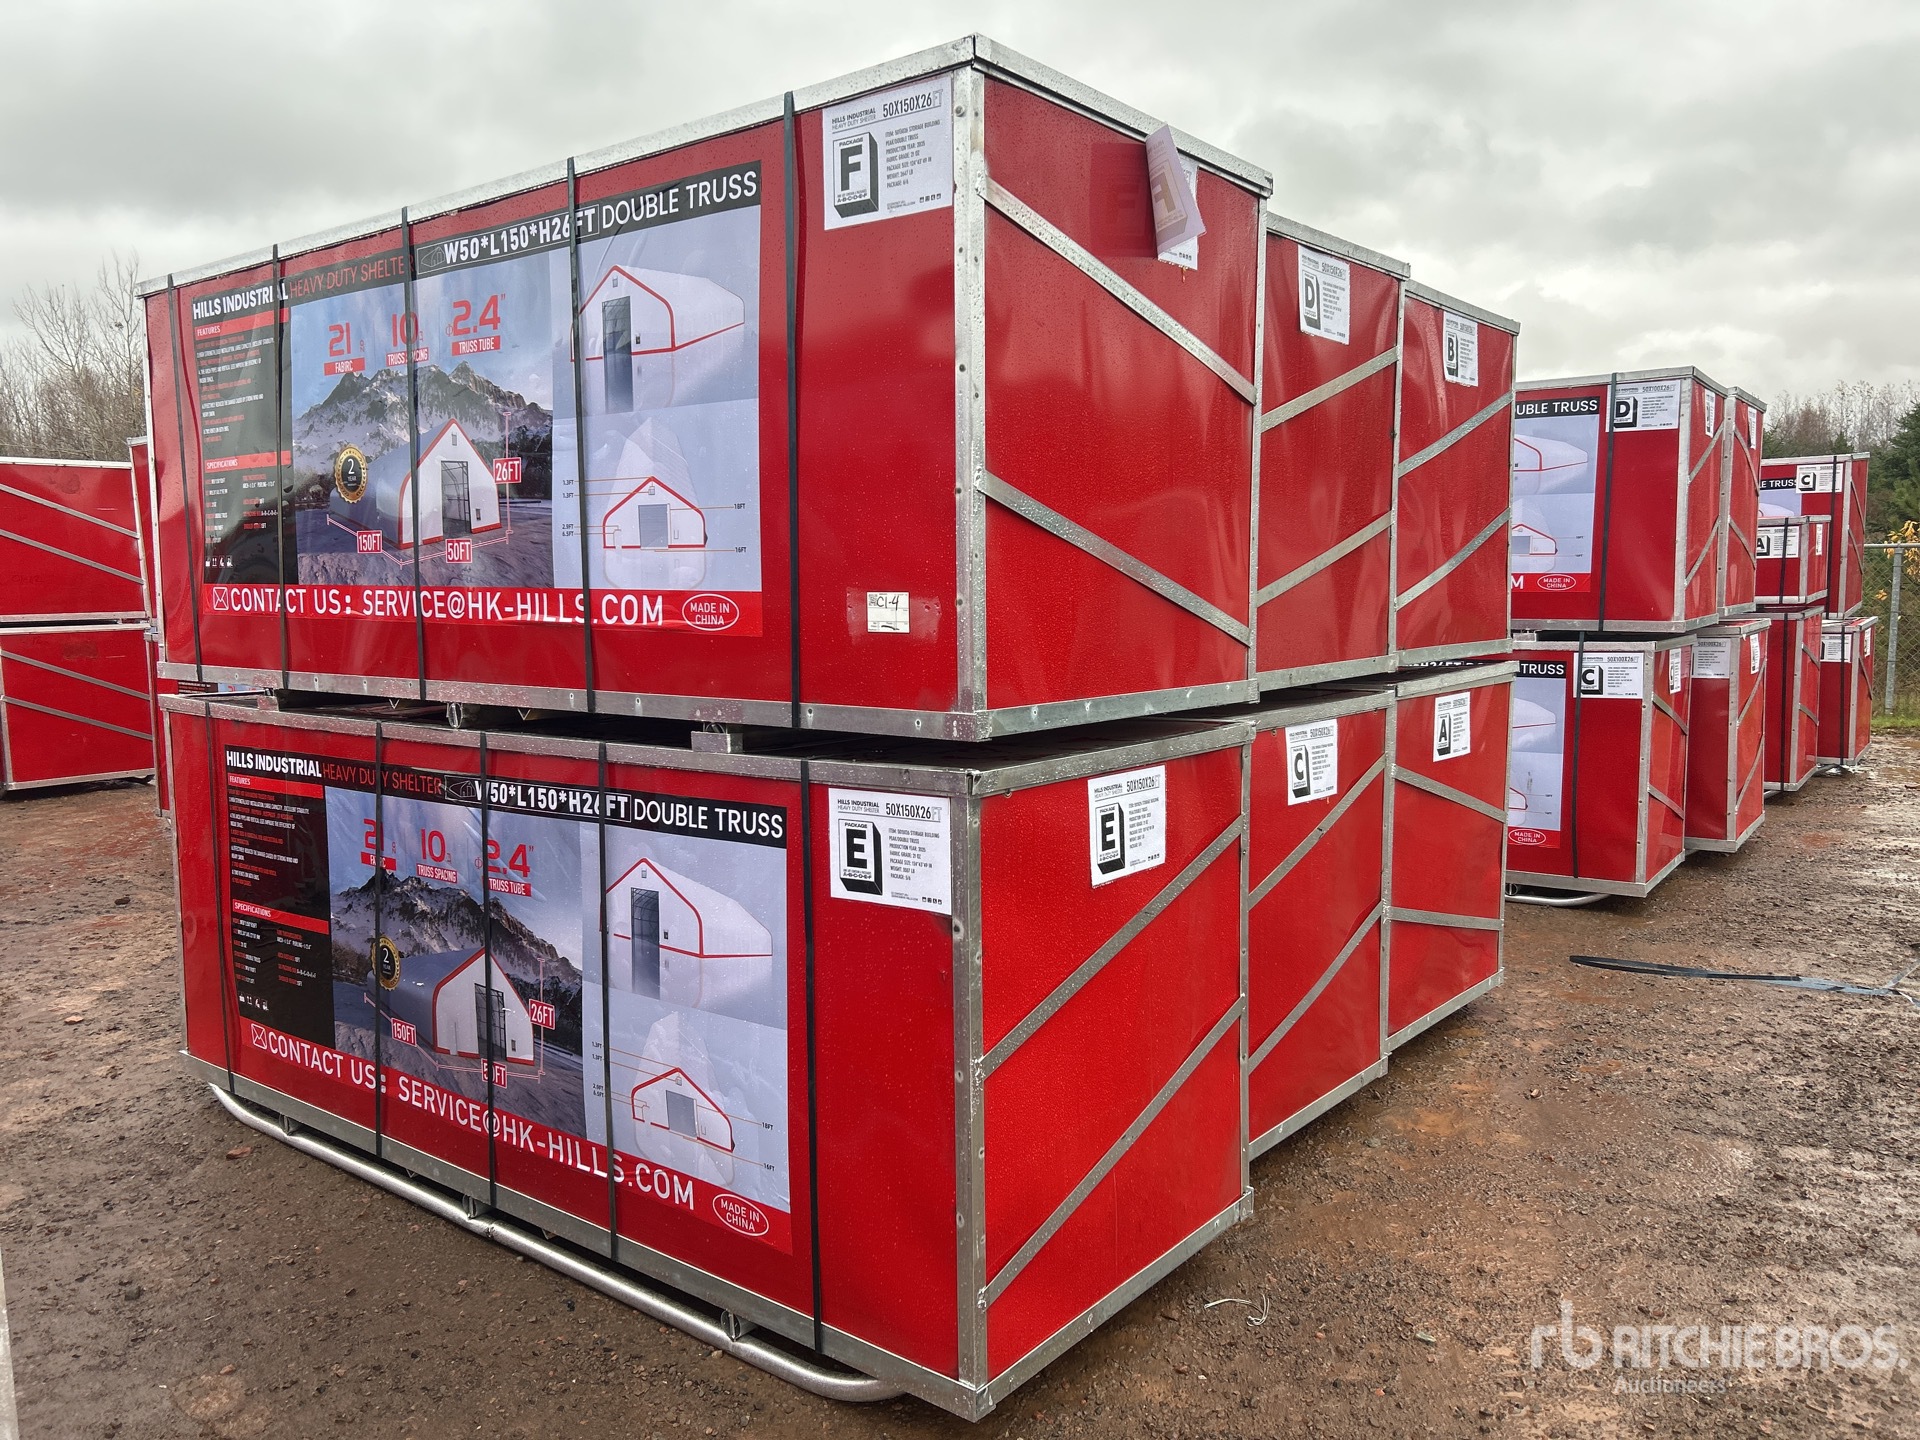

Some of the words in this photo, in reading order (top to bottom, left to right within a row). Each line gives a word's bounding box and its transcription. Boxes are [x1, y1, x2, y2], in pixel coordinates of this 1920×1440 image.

[840, 144, 862, 191] F
[193, 298, 222, 320] HILLS
[290, 273, 324, 299] HEAVY
[326, 266, 357, 290] DUTY
[361, 254, 415, 282] SHELTER
[602, 188, 679, 229] DOUBLE
[686, 170, 758, 209] TRUSS
[1305, 277, 1315, 309] D
[197, 325, 221, 337] FEATURES
[328, 322, 352, 357] 21
[458, 340, 479, 355] TRUSS
[479, 337, 495, 352] TUBE
[1448, 336, 1455, 362] B
[387, 352, 406, 367] TRUSS
[1552, 399, 1598, 414] TRUSS
[1616, 400, 1630, 418] D
[347, 458, 355, 475] 2
[494, 459, 521, 482] 26FT
[1801, 474, 1810, 486] C
[358, 532, 382, 552] 150FT
[447, 541, 471, 562] 50FT
[231, 587, 307, 614] CONTACT
[314, 588, 352, 615] US:
[690, 602, 717, 614] MADE
[719, 602, 730, 614] IN
[695, 614, 725, 625] CHINA
[1520, 663, 1565, 675] TRUSS
[1582, 668, 1594, 686] C
[1438, 719, 1448, 743] A
[1294, 752, 1304, 781] C
[229, 775, 251, 786] FEATURES
[226, 750, 253, 769] HILLS
[255, 753, 322, 778] INDUSTRIAL
[322, 762, 357, 785] HEAVY
[391, 771, 442, 795] SHELTER
[634, 798, 708, 830] DOUBLE
[714, 808, 784, 839] TRUSS
[837, 798, 850, 806] HILLS
[851, 799, 880, 808] INDUSTRIAL
[1101, 812, 1116, 852] E
[420, 828, 446, 863] 10
[846, 828, 867, 869] E
[417, 864, 434, 878] TRUSS
[434, 867, 457, 883] SPACING
[489, 878, 509, 893] TRUSS
[509, 880, 526, 895] TUBE
[234, 901, 272, 918] SPECIFICATIONS
[383, 947, 390, 964] 2
[531, 1001, 554, 1028] 26FT
[392, 1019, 416, 1044] 150FT
[268, 1031, 343, 1078] CONTACT
[398, 1075, 695, 1211] SERVICE@HK-HILLS.COM
[720, 1199, 747, 1218] MADE
[749, 1209, 760, 1224] IN
[726, 1212, 756, 1233] CHINA
